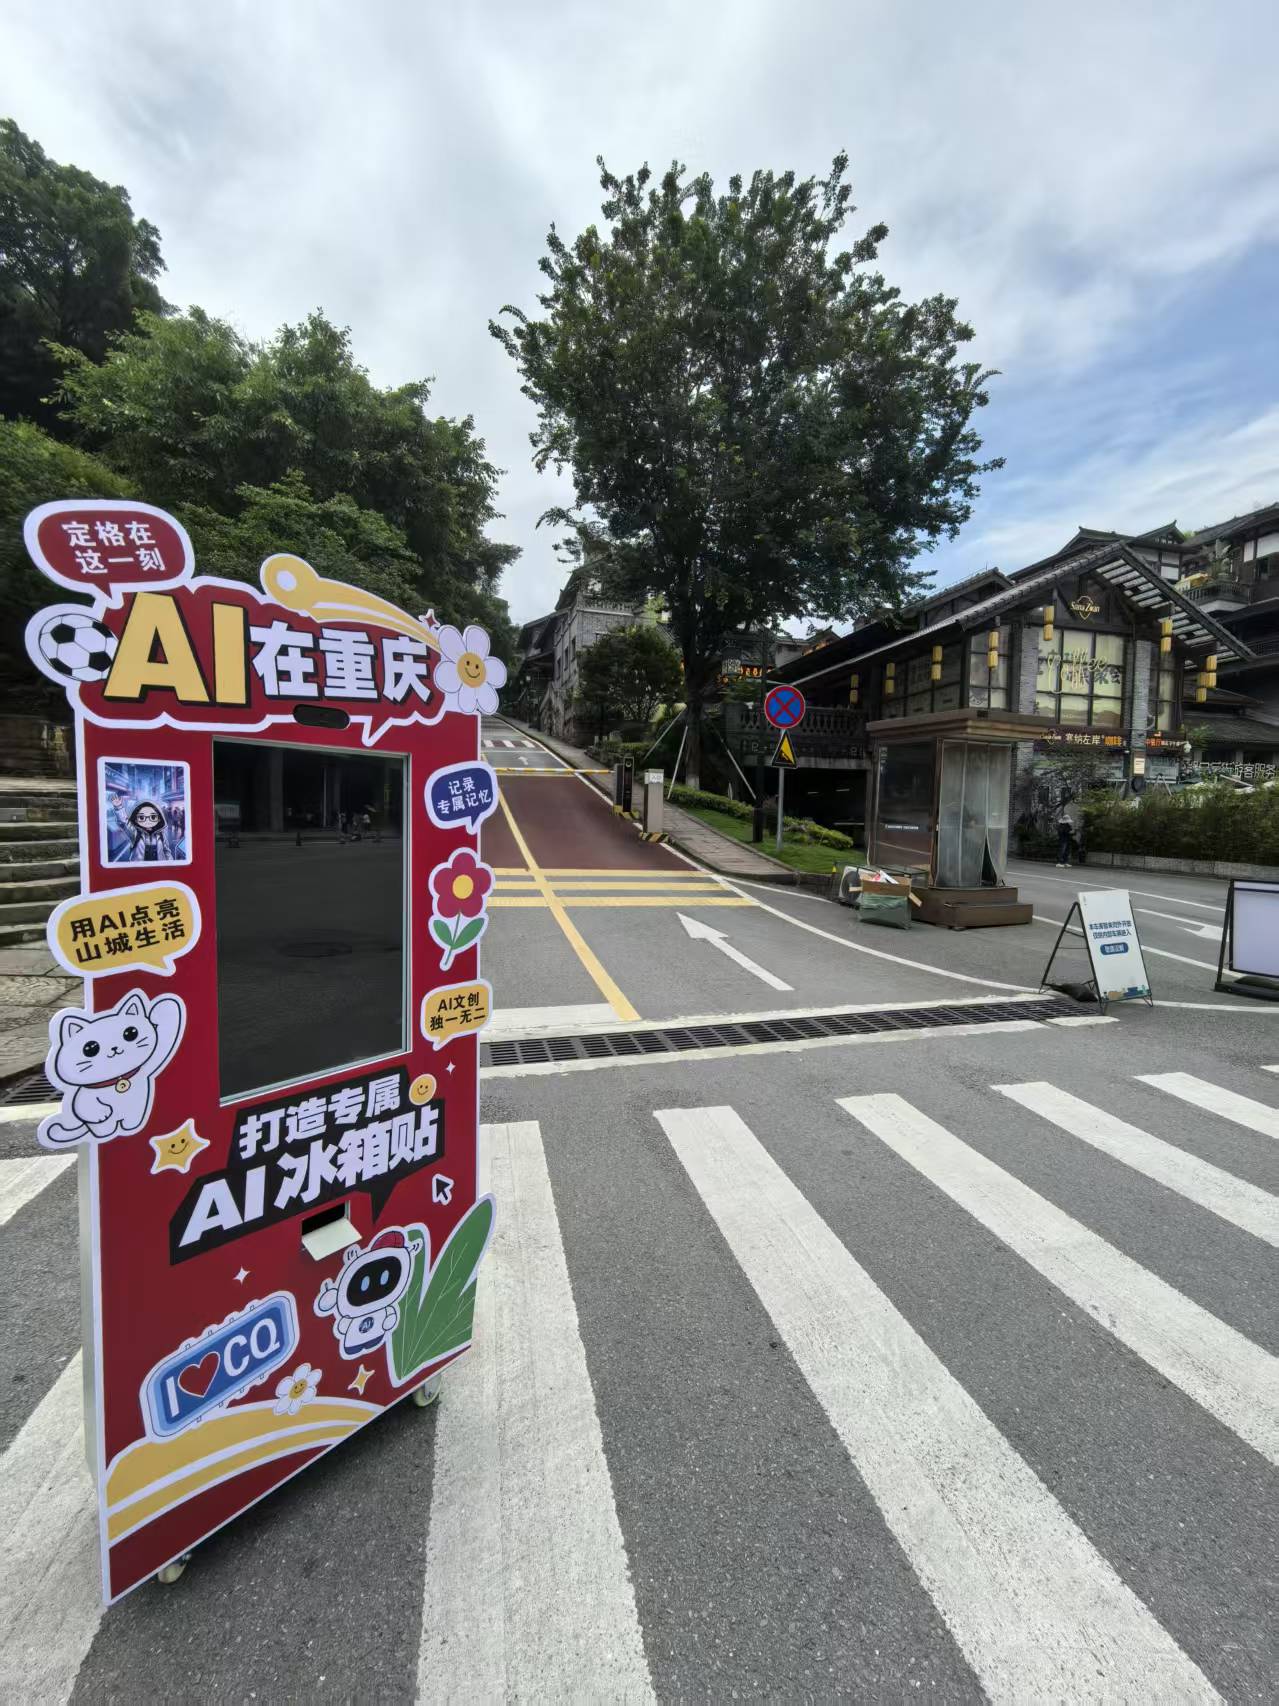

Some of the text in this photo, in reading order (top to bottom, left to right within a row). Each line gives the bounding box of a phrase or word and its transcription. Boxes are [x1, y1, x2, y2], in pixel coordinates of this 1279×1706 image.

[62, 520, 156, 548] 定格在
[75, 547, 166, 574] 这一刻
[104, 592, 433, 704] AI在重庆
[448, 778, 475, 796] 记录
[437, 791, 492, 817] 专属记忆
[70, 898, 180, 942] 用AI点亮
[76, 919, 186, 963] 山城生活
[437, 991, 480, 1012] AI文创
[430, 1007, 487, 1032] 独一无二
[239, 1074, 401, 1159] 打造专属
[223, 1317, 281, 1378] CQ
